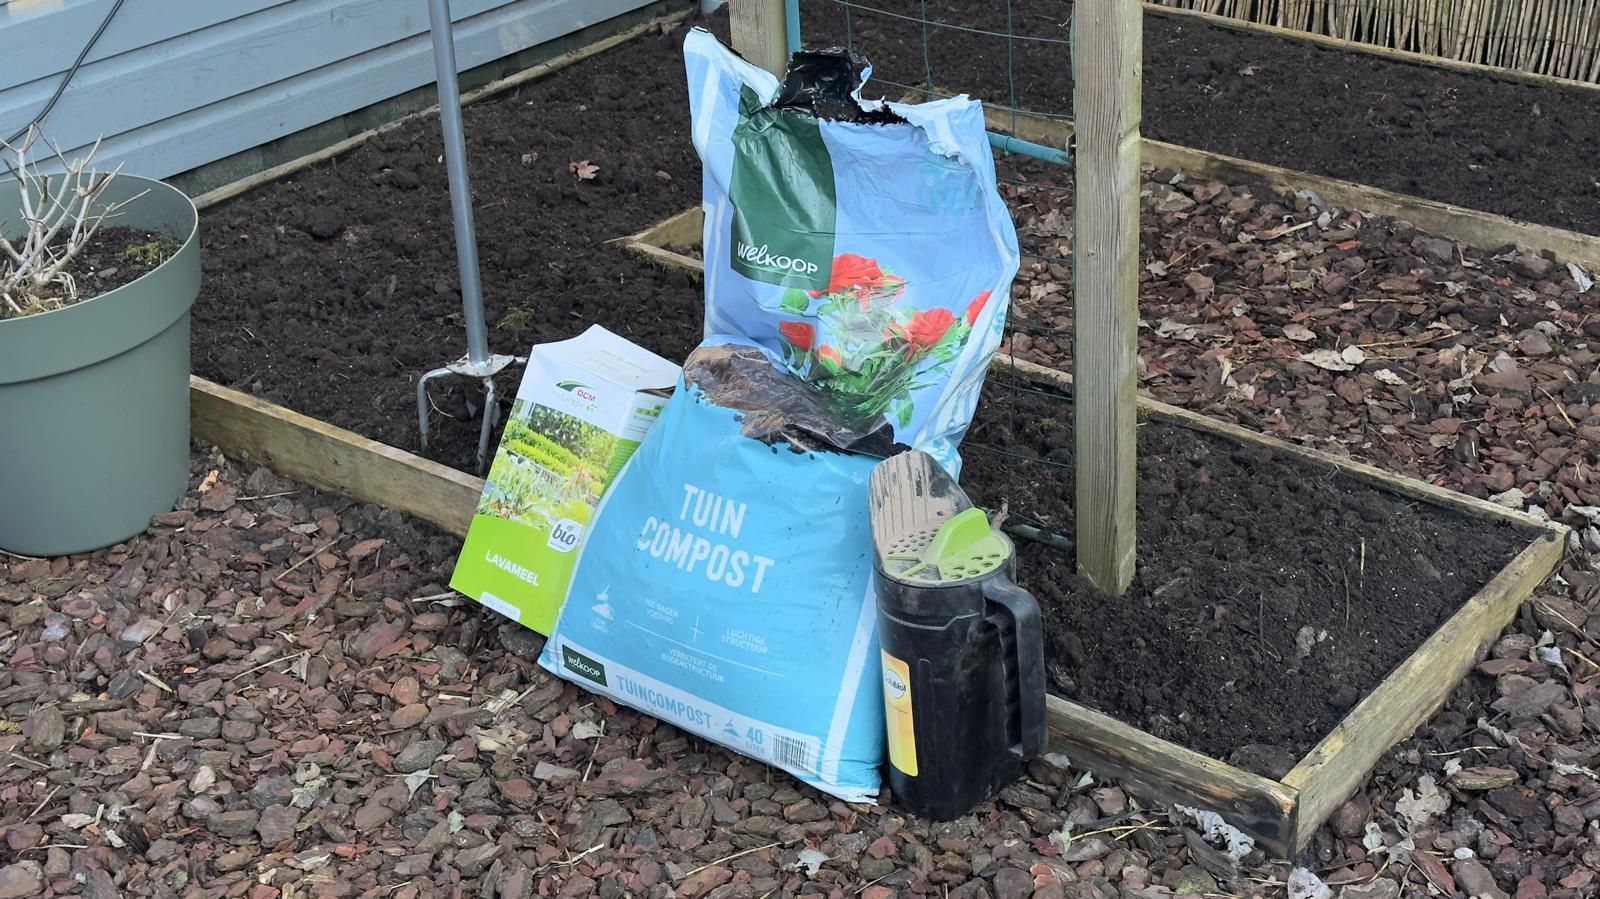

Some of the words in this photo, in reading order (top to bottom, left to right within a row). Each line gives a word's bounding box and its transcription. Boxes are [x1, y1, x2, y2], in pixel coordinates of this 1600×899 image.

[576, 389, 596, 402] DCM
[680, 483, 747, 539] TUIN
[552, 524, 577, 546] bio
[636, 516, 775, 593] COMPOST
[485, 549, 540, 587] LAVAMEEL
[656, 602, 680, 618] DAGEN
[721, 634, 768, 656] STRUCTUUR
[726, 627, 766, 646] LUCHTIGE
[669, 648, 707, 668] VERBETERT
[707, 662, 718, 672] DE
[616, 675, 712, 729] TUINCOMPOST
[747, 726, 763, 745] 40
